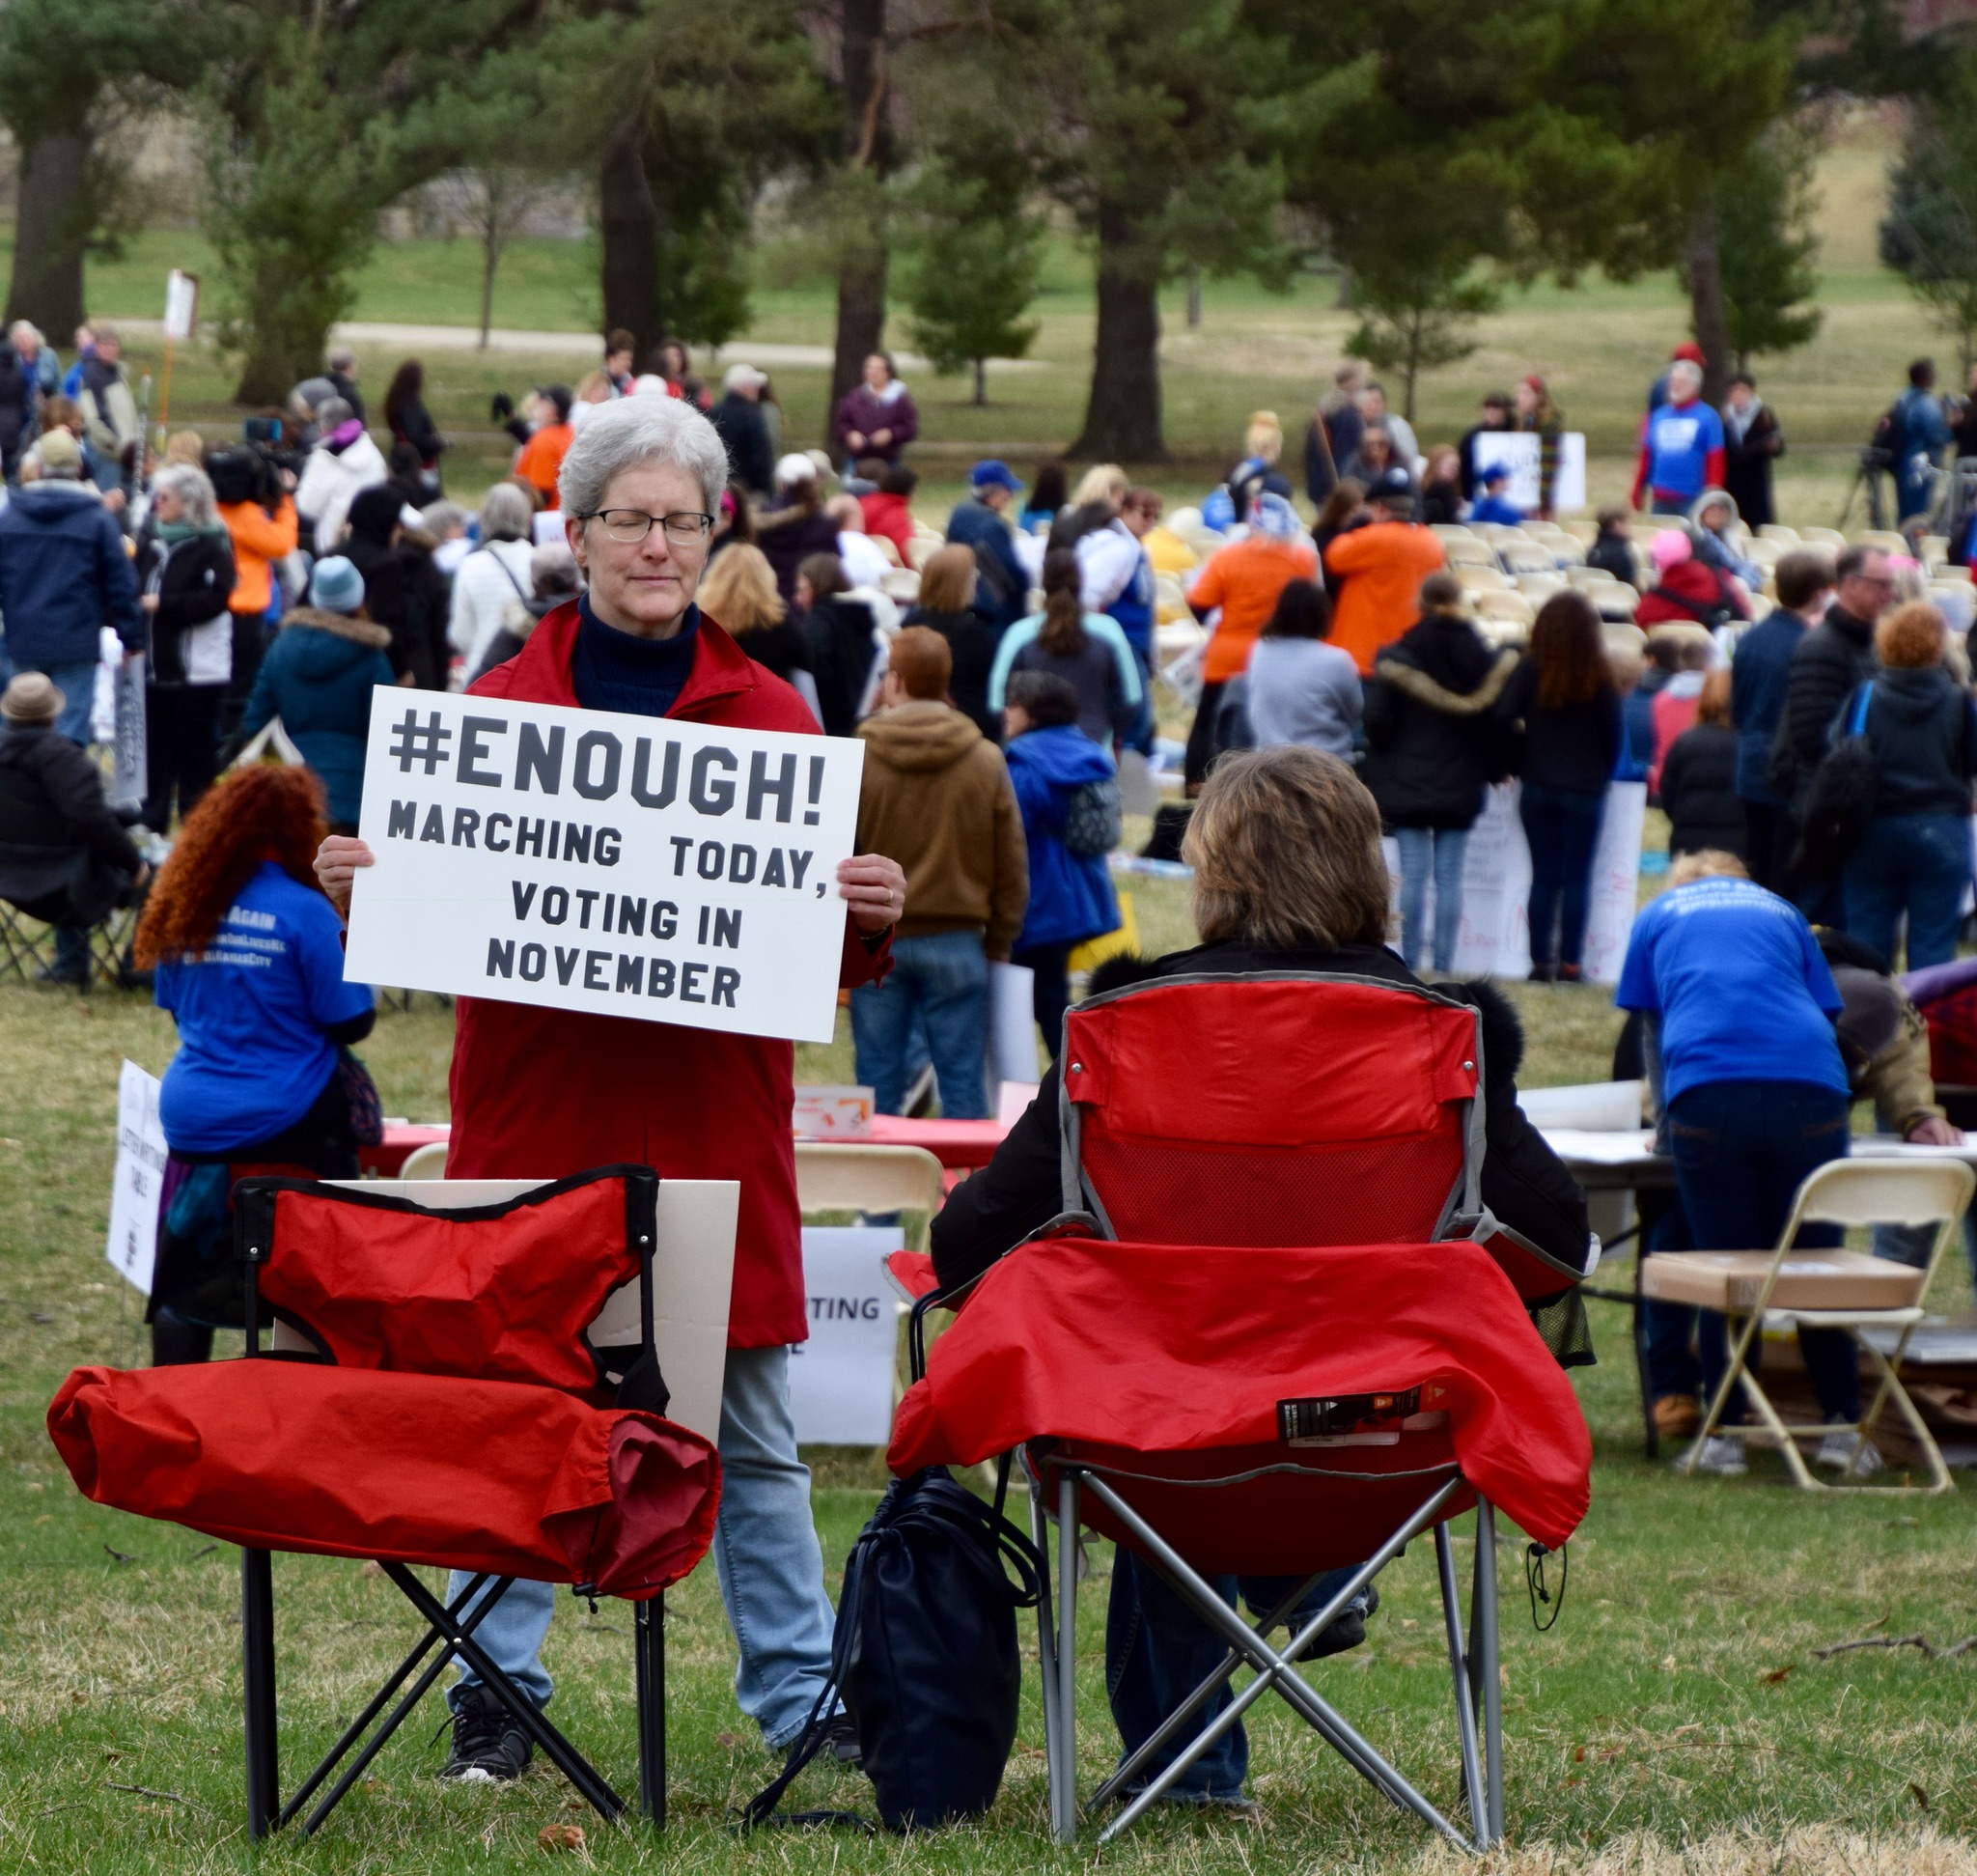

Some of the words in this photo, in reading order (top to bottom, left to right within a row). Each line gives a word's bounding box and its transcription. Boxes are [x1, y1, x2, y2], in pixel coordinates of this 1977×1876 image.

[388, 709, 825, 826] #ENOUGH!
[387, 799, 622, 867] MARCHING
[670, 836, 827, 898] TODAY,
[512, 881, 679, 940] VOTING
[698, 905, 742, 949] IN
[487, 938, 741, 1008] NOVEMBER
[806, 1298, 880, 1320] TING
